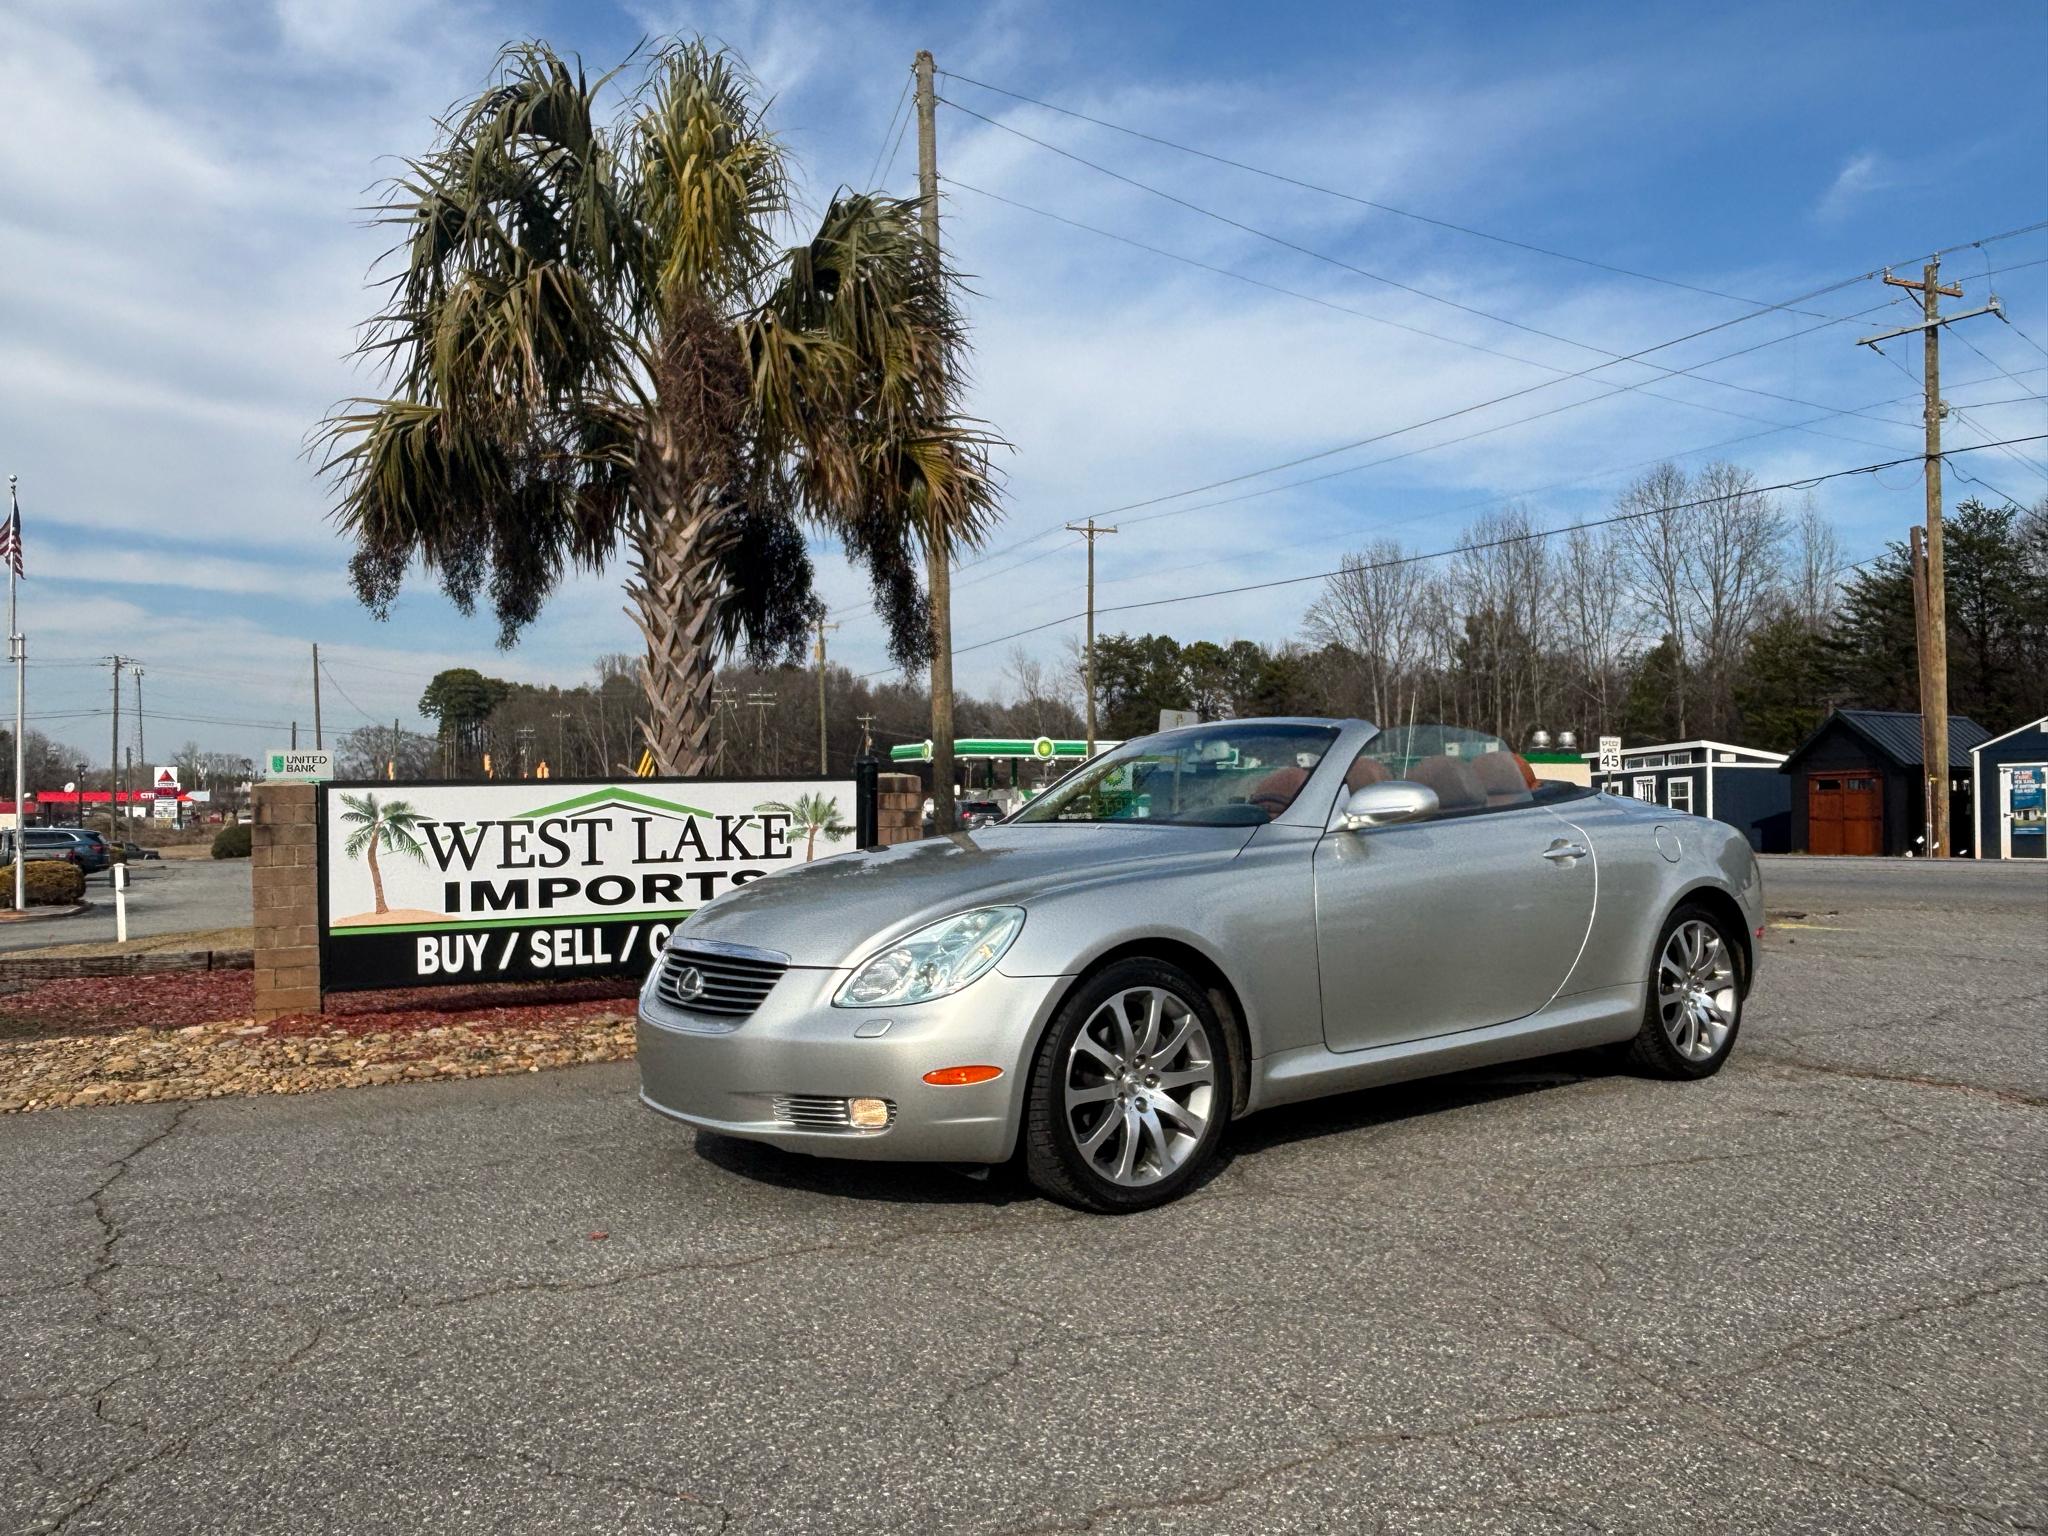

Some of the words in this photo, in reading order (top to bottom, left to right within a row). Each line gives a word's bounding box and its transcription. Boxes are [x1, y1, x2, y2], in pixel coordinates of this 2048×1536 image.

[286, 755, 328, 764] UNITED
[1601, 754, 1619, 767] 45
[286, 764, 316, 773] BANK
[417, 818, 613, 872] WEST
[631, 814, 793, 864] LAKE
[417, 933, 490, 975] BUY
[530, 927, 612, 968] SELL
